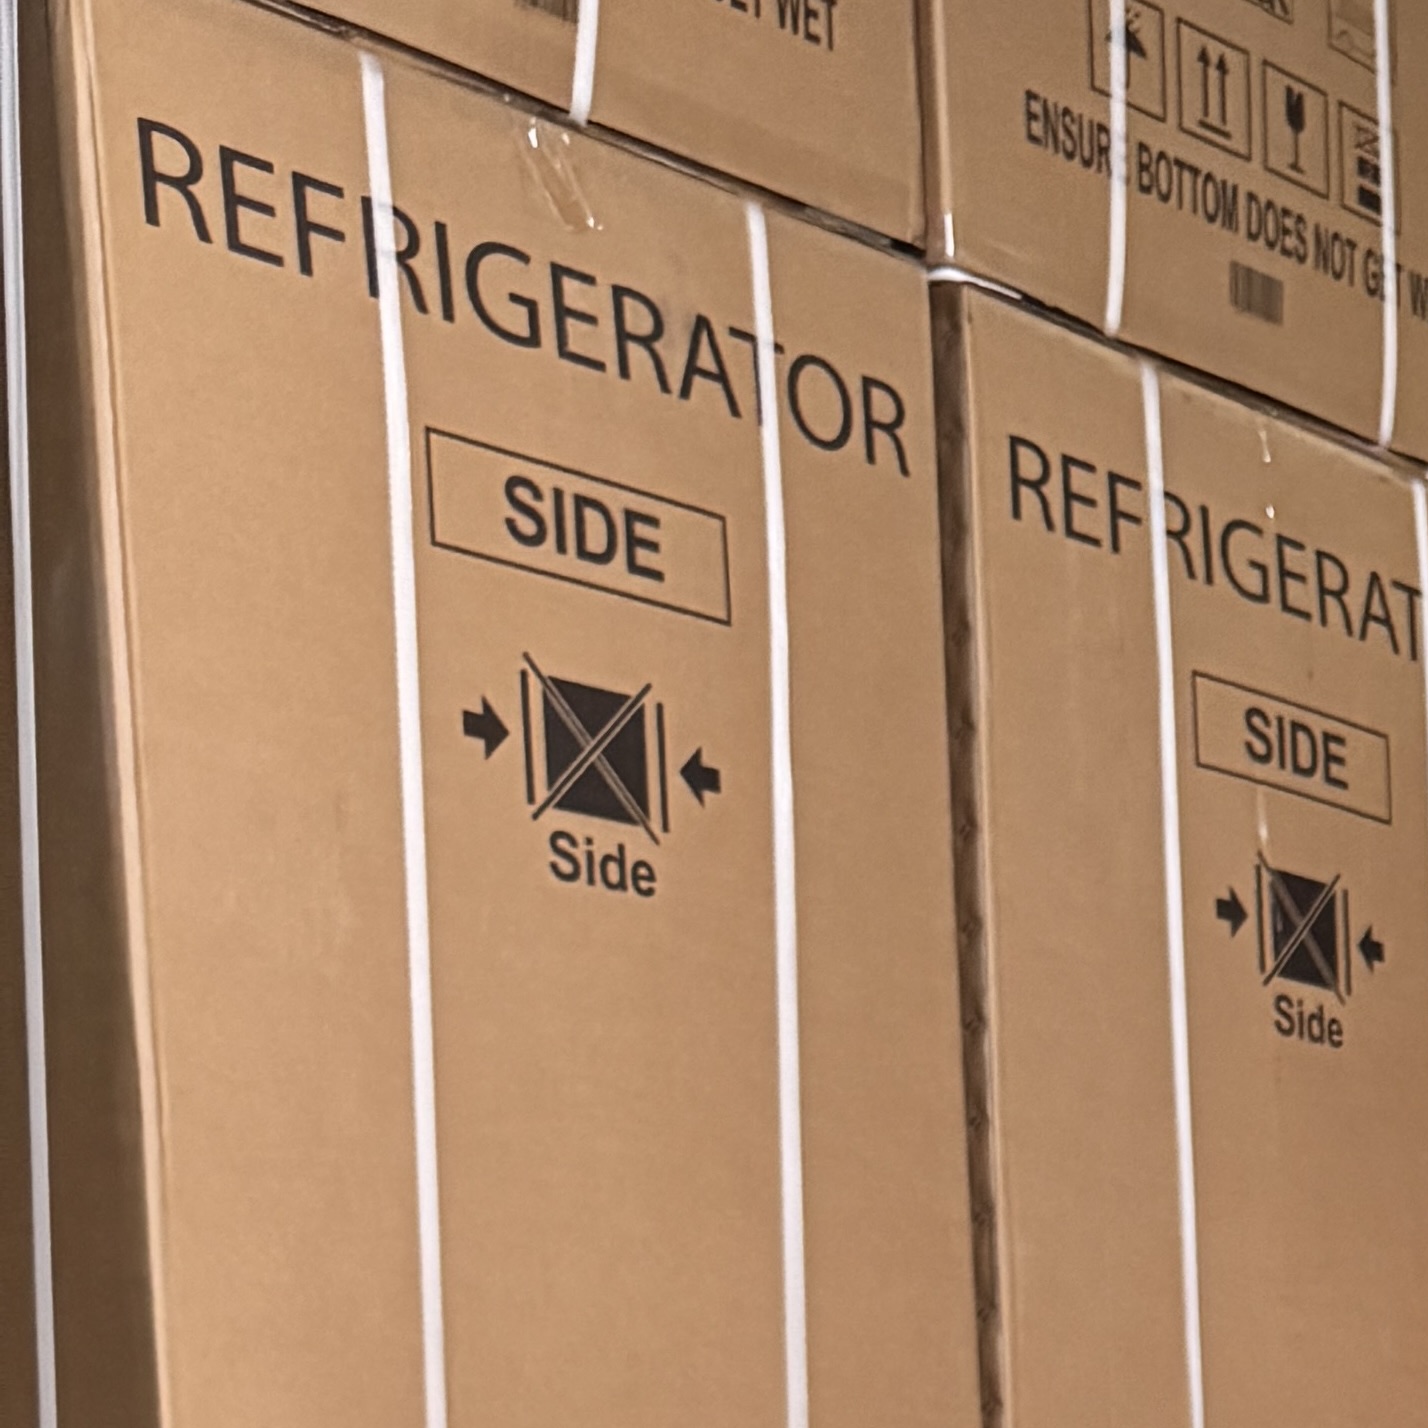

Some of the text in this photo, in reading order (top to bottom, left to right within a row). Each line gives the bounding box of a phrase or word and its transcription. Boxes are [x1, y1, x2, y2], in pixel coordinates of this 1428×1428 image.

[1025, 89, 1128, 184] ENSUR
[1138, 141, 1239, 234] BOTTOM
[1246, 191, 1308, 267] DOES
[1314, 223, 1357, 288] NOT
[1362, 248, 1402, 310] GT
[136, 117, 911, 478] REFRIGERATOR
[504, 475, 665, 583] SIDE
[1244, 707, 1348, 791] SIDE
[548, 830, 658, 897] Side
[1274, 994, 1344, 1048] Side
